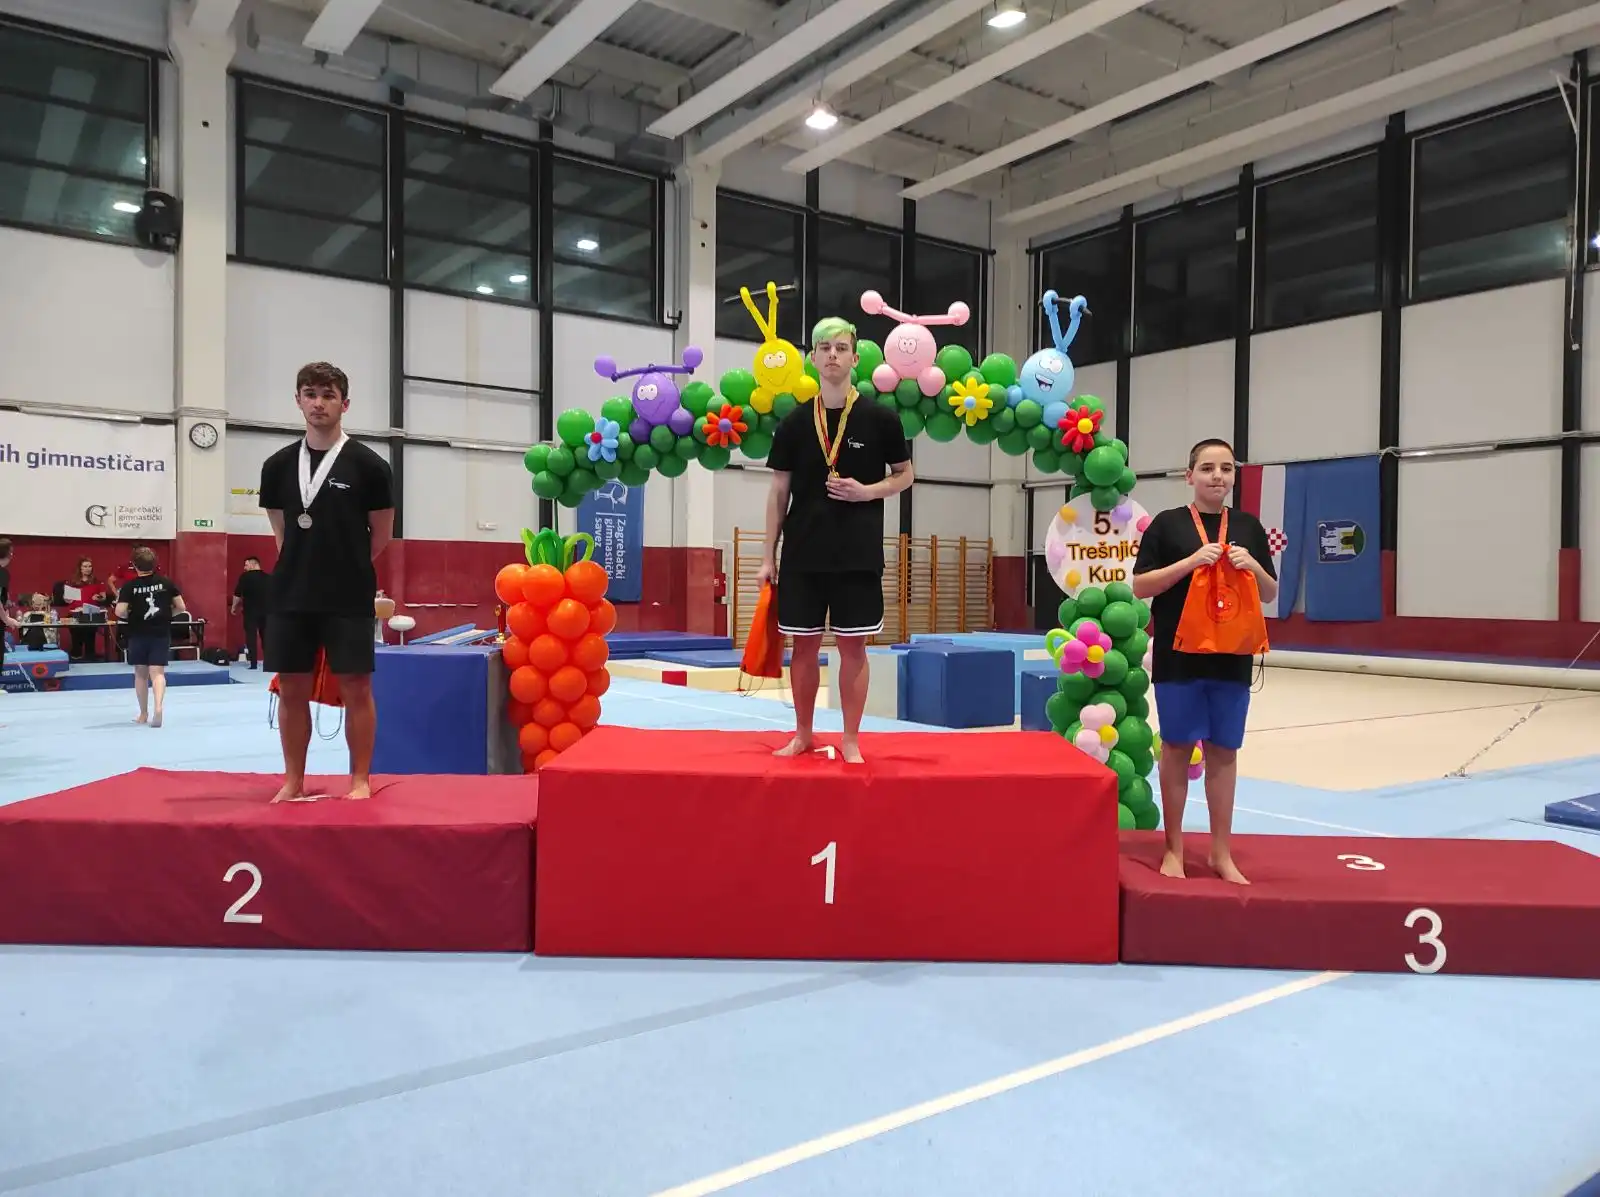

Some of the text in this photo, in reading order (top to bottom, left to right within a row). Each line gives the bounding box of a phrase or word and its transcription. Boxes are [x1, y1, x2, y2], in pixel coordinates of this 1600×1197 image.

[26, 448, 165, 472] gimnastičara
[119, 505, 162, 514] Zagrebački
[119, 514, 163, 522] gimnastički
[1094, 511, 1119, 535] 5.
[604, 518, 614, 580] gimnastički
[615, 519, 626, 579] Zagrebački
[1088, 565, 1126, 583] Kup
[811, 841, 837, 905] 1
[1336, 853, 1386, 871] 3
[222, 861, 263, 924] 2
[1404, 907, 1447, 975] 3
